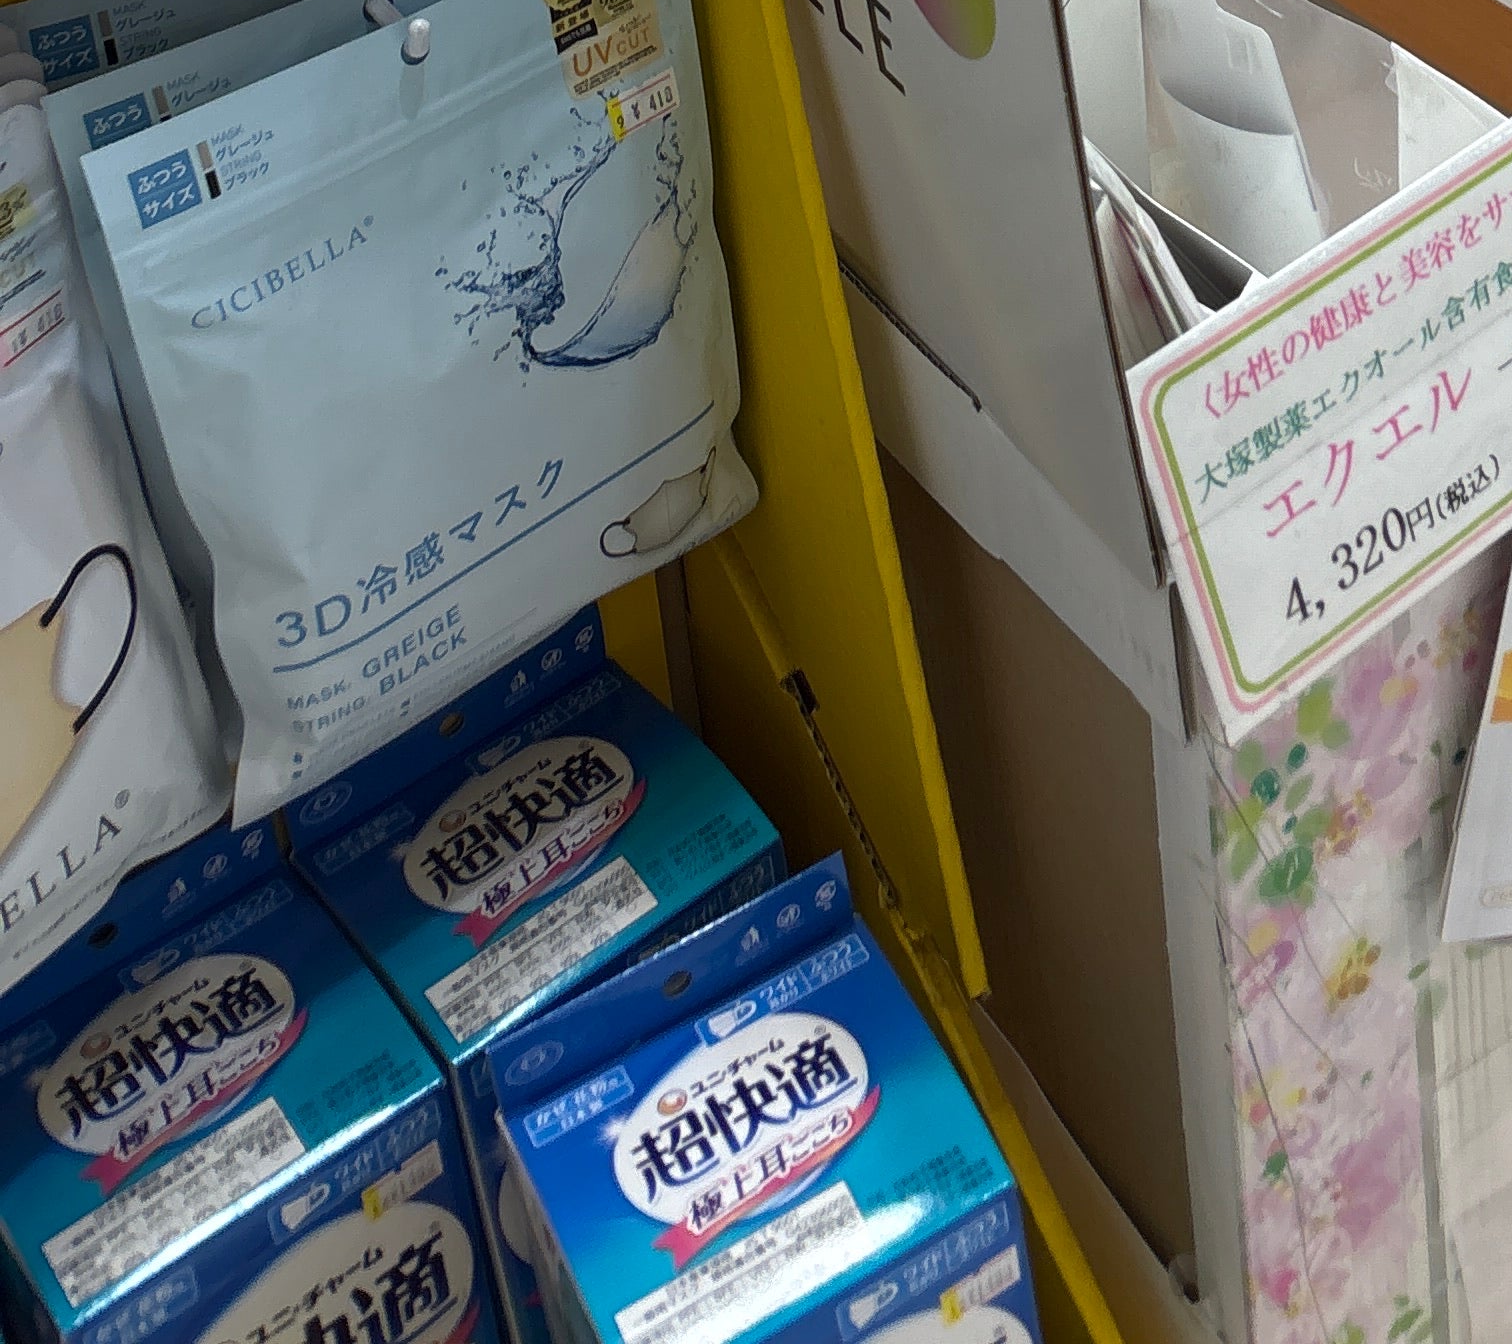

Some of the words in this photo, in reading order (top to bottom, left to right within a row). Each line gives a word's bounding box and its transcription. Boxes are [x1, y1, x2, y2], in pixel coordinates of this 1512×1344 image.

[142, 185, 196, 219] サイズ
[1263, 368, 1473, 541] エクエル
[273, 457, 566, 652] 3D冷感マスク
[362, 605, 464, 679] GREIGE
[380, 628, 469, 697] BLACK
[420, 747, 625, 903] 超快適
[55, 967, 284, 1140] 超快適
[630, 1030, 858, 1205] 超快適
